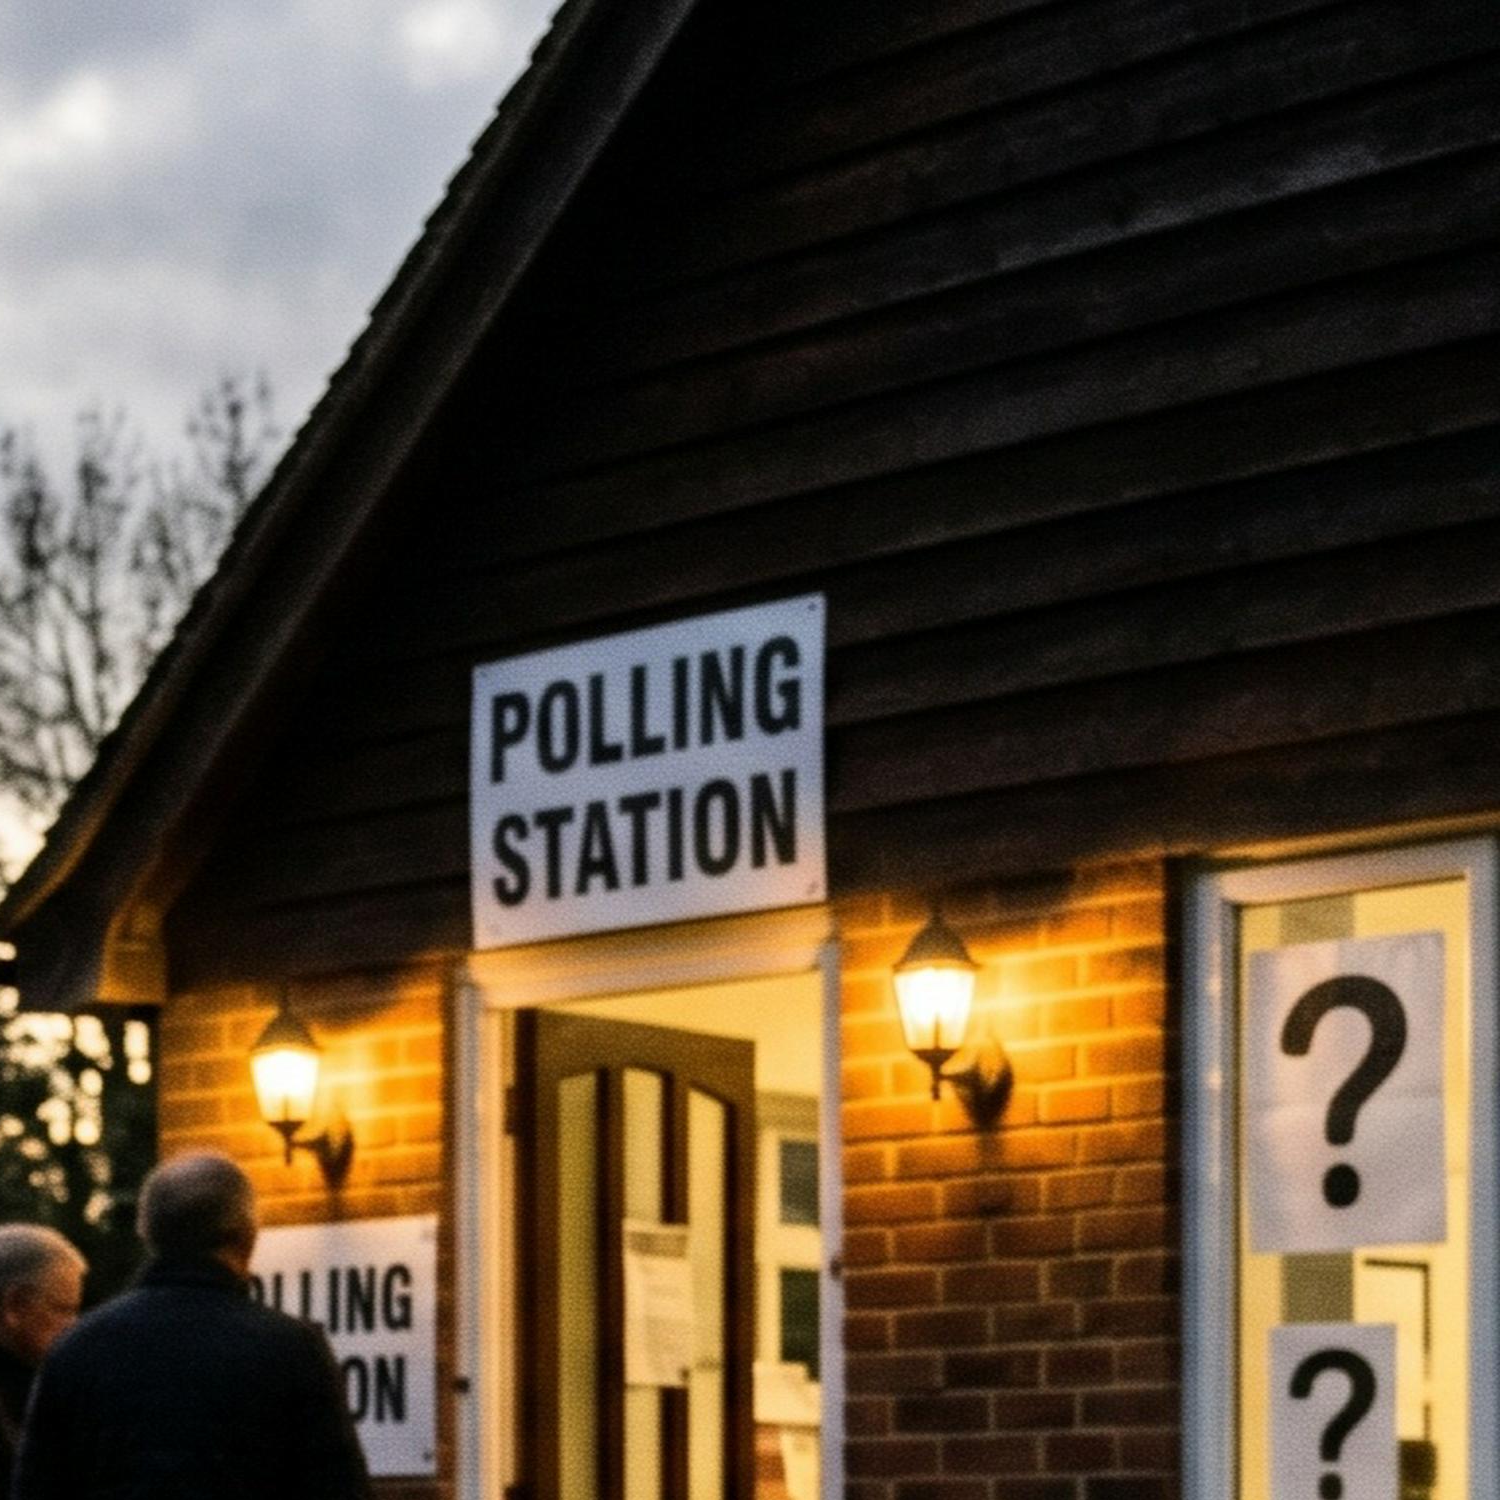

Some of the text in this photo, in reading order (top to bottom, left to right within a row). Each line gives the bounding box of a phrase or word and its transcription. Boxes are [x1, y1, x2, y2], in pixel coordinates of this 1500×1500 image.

[490, 636, 801, 784] POLLING
[492, 769, 798, 906] STATION
[1280, 974, 1408, 1210] ?
